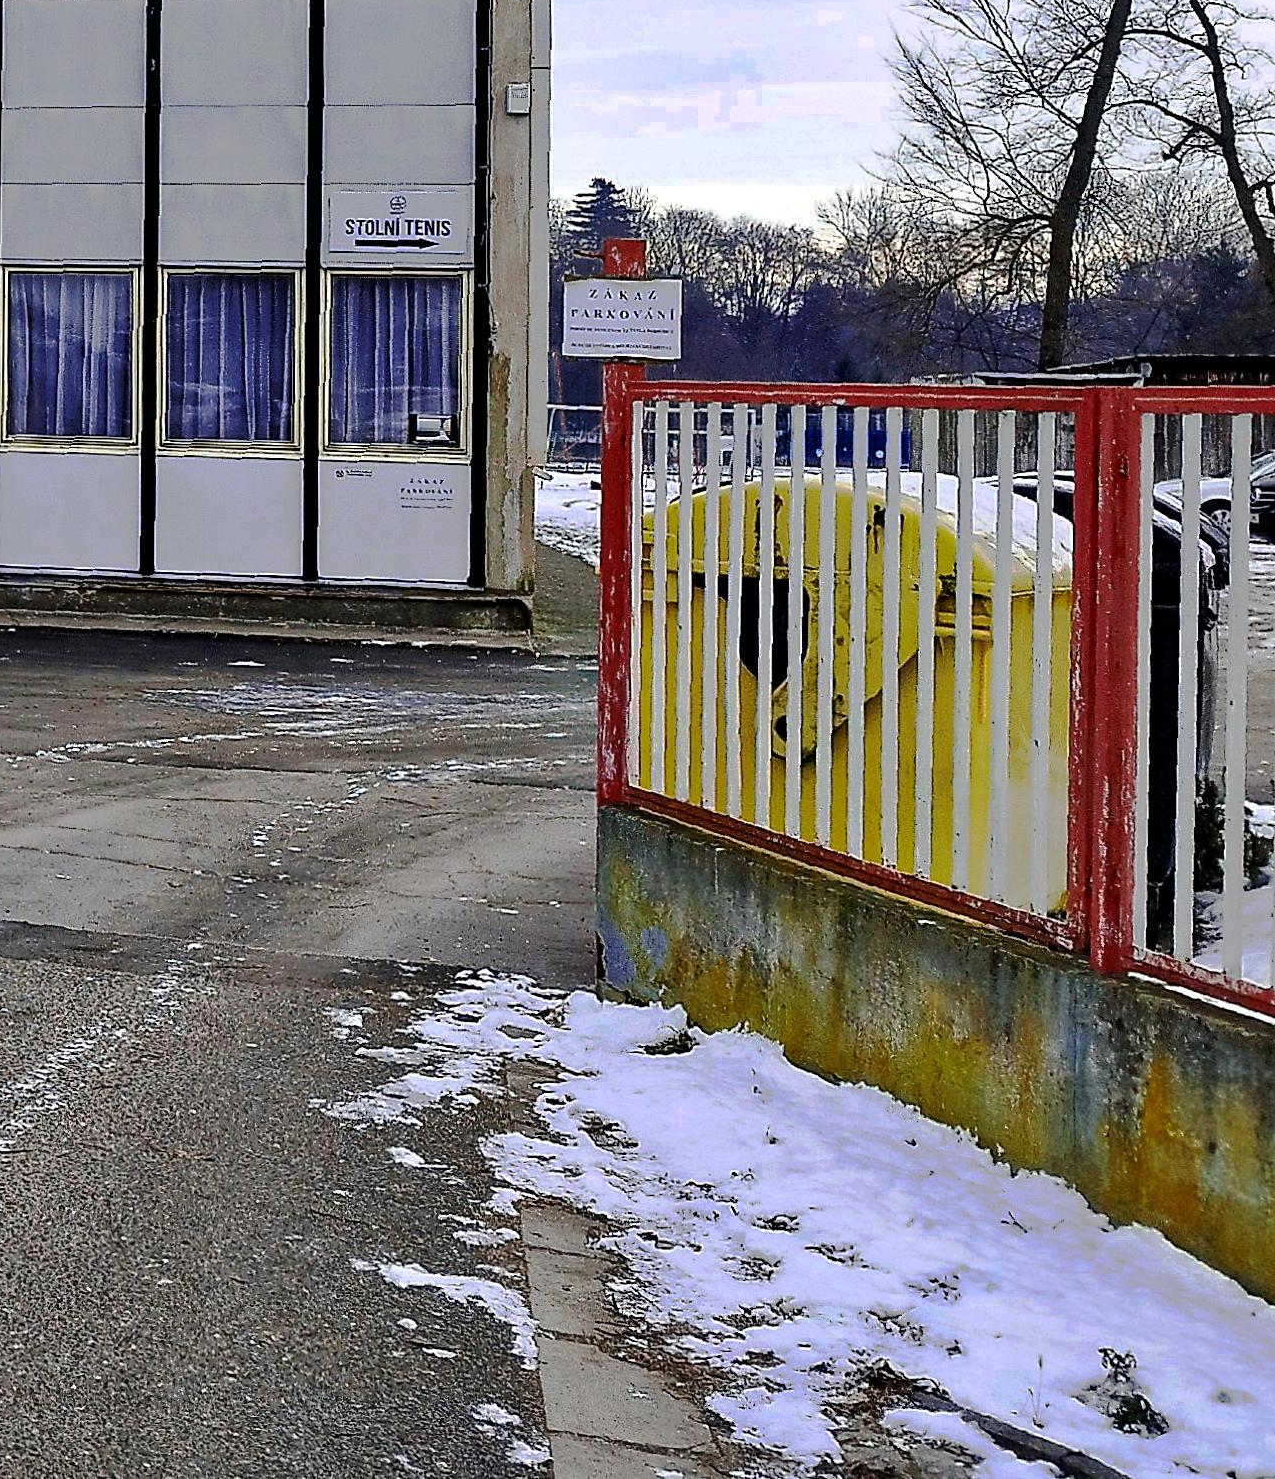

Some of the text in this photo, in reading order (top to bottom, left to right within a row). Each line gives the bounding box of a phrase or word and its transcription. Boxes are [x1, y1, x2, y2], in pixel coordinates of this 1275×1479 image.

[345, 217, 451, 237] STOLNÍ TENIS
[589, 287, 657, 301] ZÁKAZ
[571, 307, 674, 321] PARKOVÁNÍ
